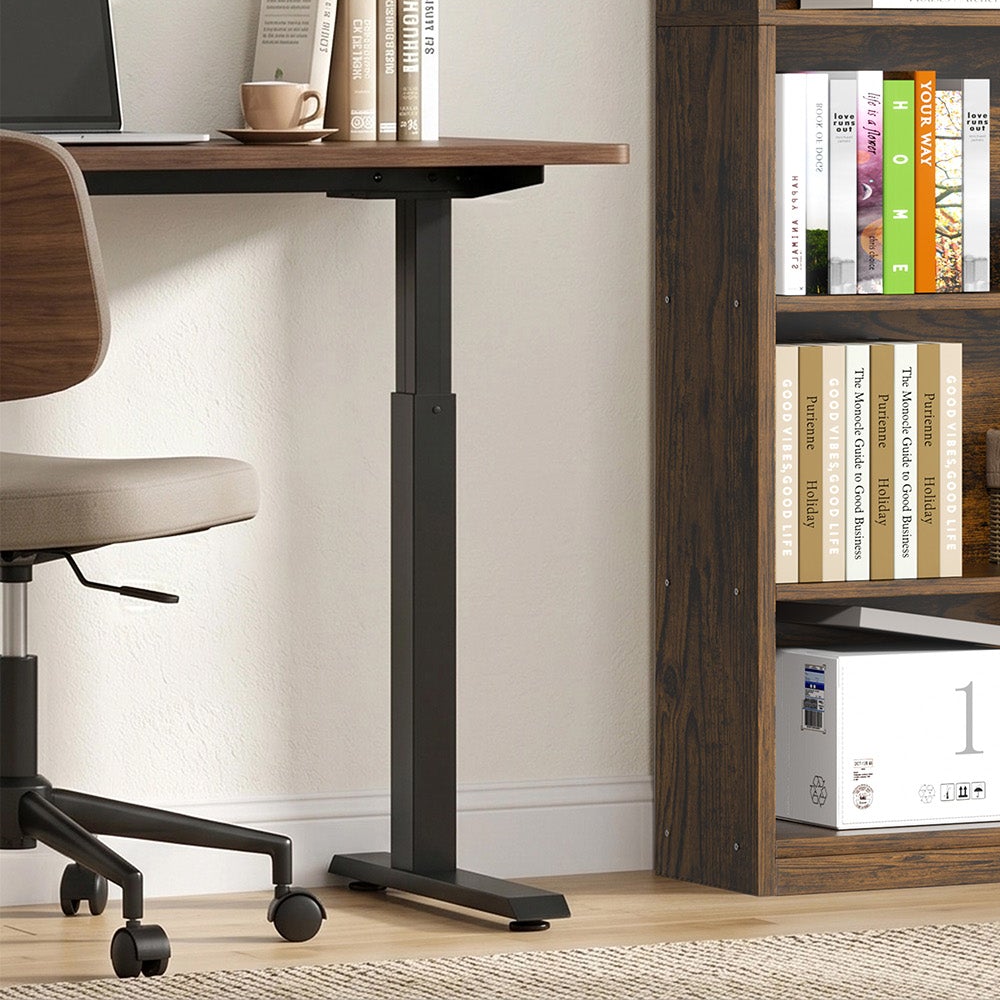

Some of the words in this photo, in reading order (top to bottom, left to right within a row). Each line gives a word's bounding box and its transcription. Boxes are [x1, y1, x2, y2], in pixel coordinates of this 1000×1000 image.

[863, 92, 880, 108] life
[867, 109, 876, 117] is
[920, 80, 932, 127] YOUR
[863, 127, 880, 154] flower
[920, 132, 932, 167] WAY
[892, 100, 908, 273] HOME
[854, 368, 865, 389] The
[901, 367, 912, 387] The
[946, 375, 957, 418] GOOD
[782, 379, 792, 422] GOOD
[828, 378, 839, 421] GOOD
[854, 392, 865, 436] Monocle
[901, 391, 912, 434] Monocle
[924, 393, 935, 447] Purienne
[806, 396, 818, 450] Purienne
[878, 394, 889, 449] Purienne
[780, 426, 792, 473] VIBES,
[827, 425, 839, 471] VIBES,
[854, 438, 865, 469] Guide
[901, 437, 912, 468] Guide
[945, 421, 957, 468] VIBES,
[782, 474, 792, 519] GOOD
[828, 474, 839, 518] GOOD
[854, 472, 865, 483] to
[901, 471, 912, 482] to
[901, 483, 912, 512] Good
[946, 470, 957, 514] GOOD
[805, 480, 818, 528] Holiday
[854, 485, 865, 514] Good
[875, 478, 889, 526] Holiday
[921, 476, 935, 525] Holiday
[782, 525, 792, 556] LIFE
[828, 523, 839, 555] LIFE
[854, 517, 865, 560] Business
[901, 515, 912, 558] Business
[946, 519, 957, 550] LIFE
[955, 681, 984, 755] 1
